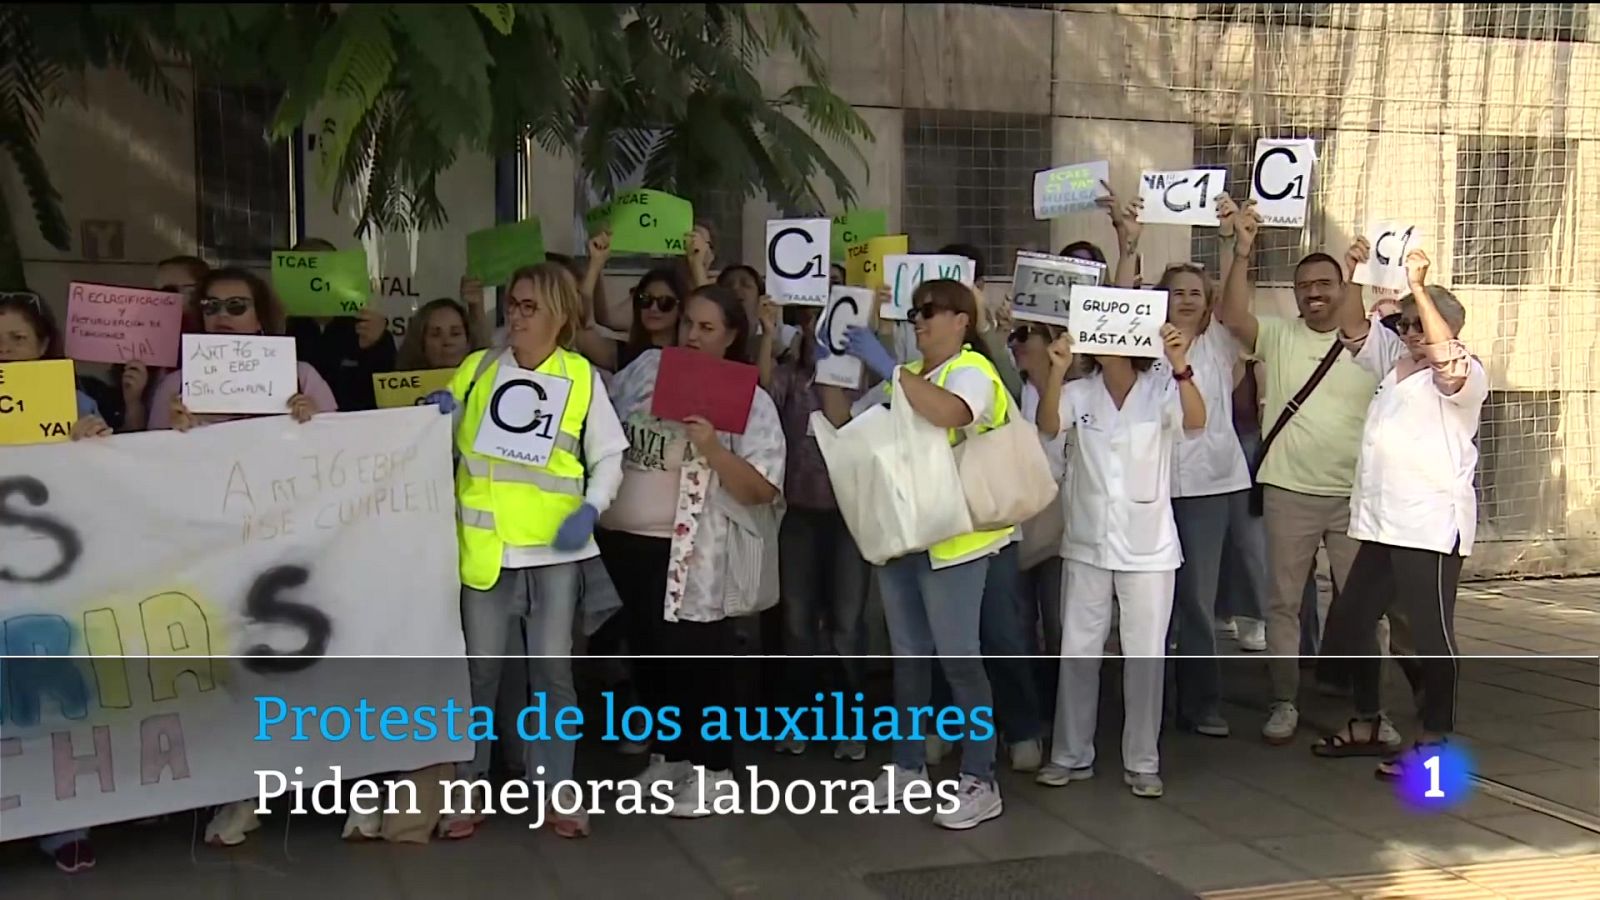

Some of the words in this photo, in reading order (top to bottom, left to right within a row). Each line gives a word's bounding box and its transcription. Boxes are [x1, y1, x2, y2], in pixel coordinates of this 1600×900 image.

[1255, 147, 1305, 200] C1
[1163, 173, 1210, 213] C1
[639, 213, 657, 228] C1
[833, 216, 847, 225] AE
[768, 227, 827, 280] C1
[1376, 225, 1415, 266] C1
[277, 255, 318, 269] TCAE
[863, 260, 877, 273] C1
[310, 277, 331, 292] C1
[1014, 292, 1038, 308] C1
[1082, 299, 1130, 315] GRUPO
[1135, 304, 1151, 316] C1
[827, 296, 858, 356] C
[1079, 331, 1127, 346] BASTA
[1133, 335, 1152, 347] YA
[232, 340, 252, 358] 76
[378, 376, 422, 390] TCAE
[490, 379, 554, 440] C1
